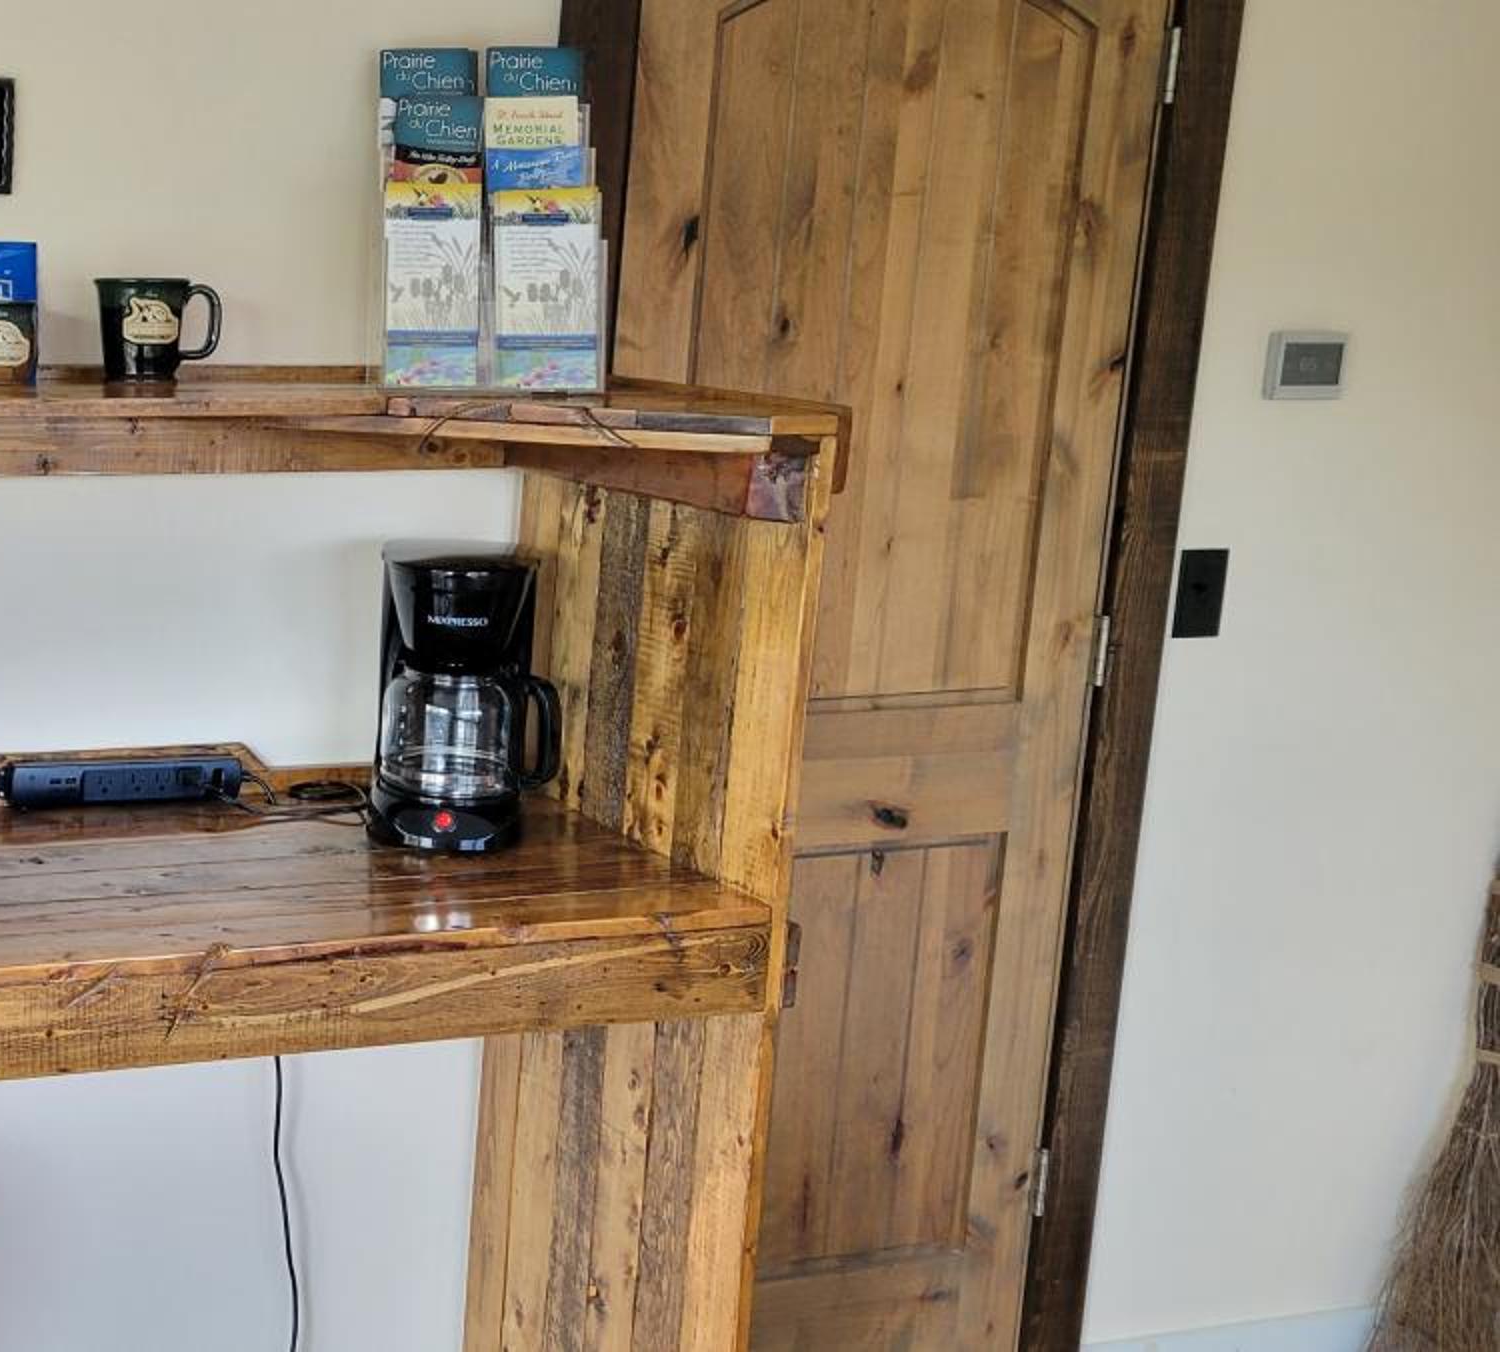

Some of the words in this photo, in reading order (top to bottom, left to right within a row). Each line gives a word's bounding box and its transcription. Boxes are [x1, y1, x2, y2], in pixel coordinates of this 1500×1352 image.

[383, 51, 436, 70] Prairie
[490, 51, 543, 70] Prairie
[395, 70, 411, 82] du
[411, 71, 465, 90] Chien
[503, 71, 519, 83] du
[519, 71, 572, 92] Chien
[398, 99, 451, 118] Prairie
[409, 117, 424, 129] du
[425, 119, 477, 140] Chien
[493, 122, 564, 134] MEMORIAL
[496, 135, 562, 145] GARDENS
